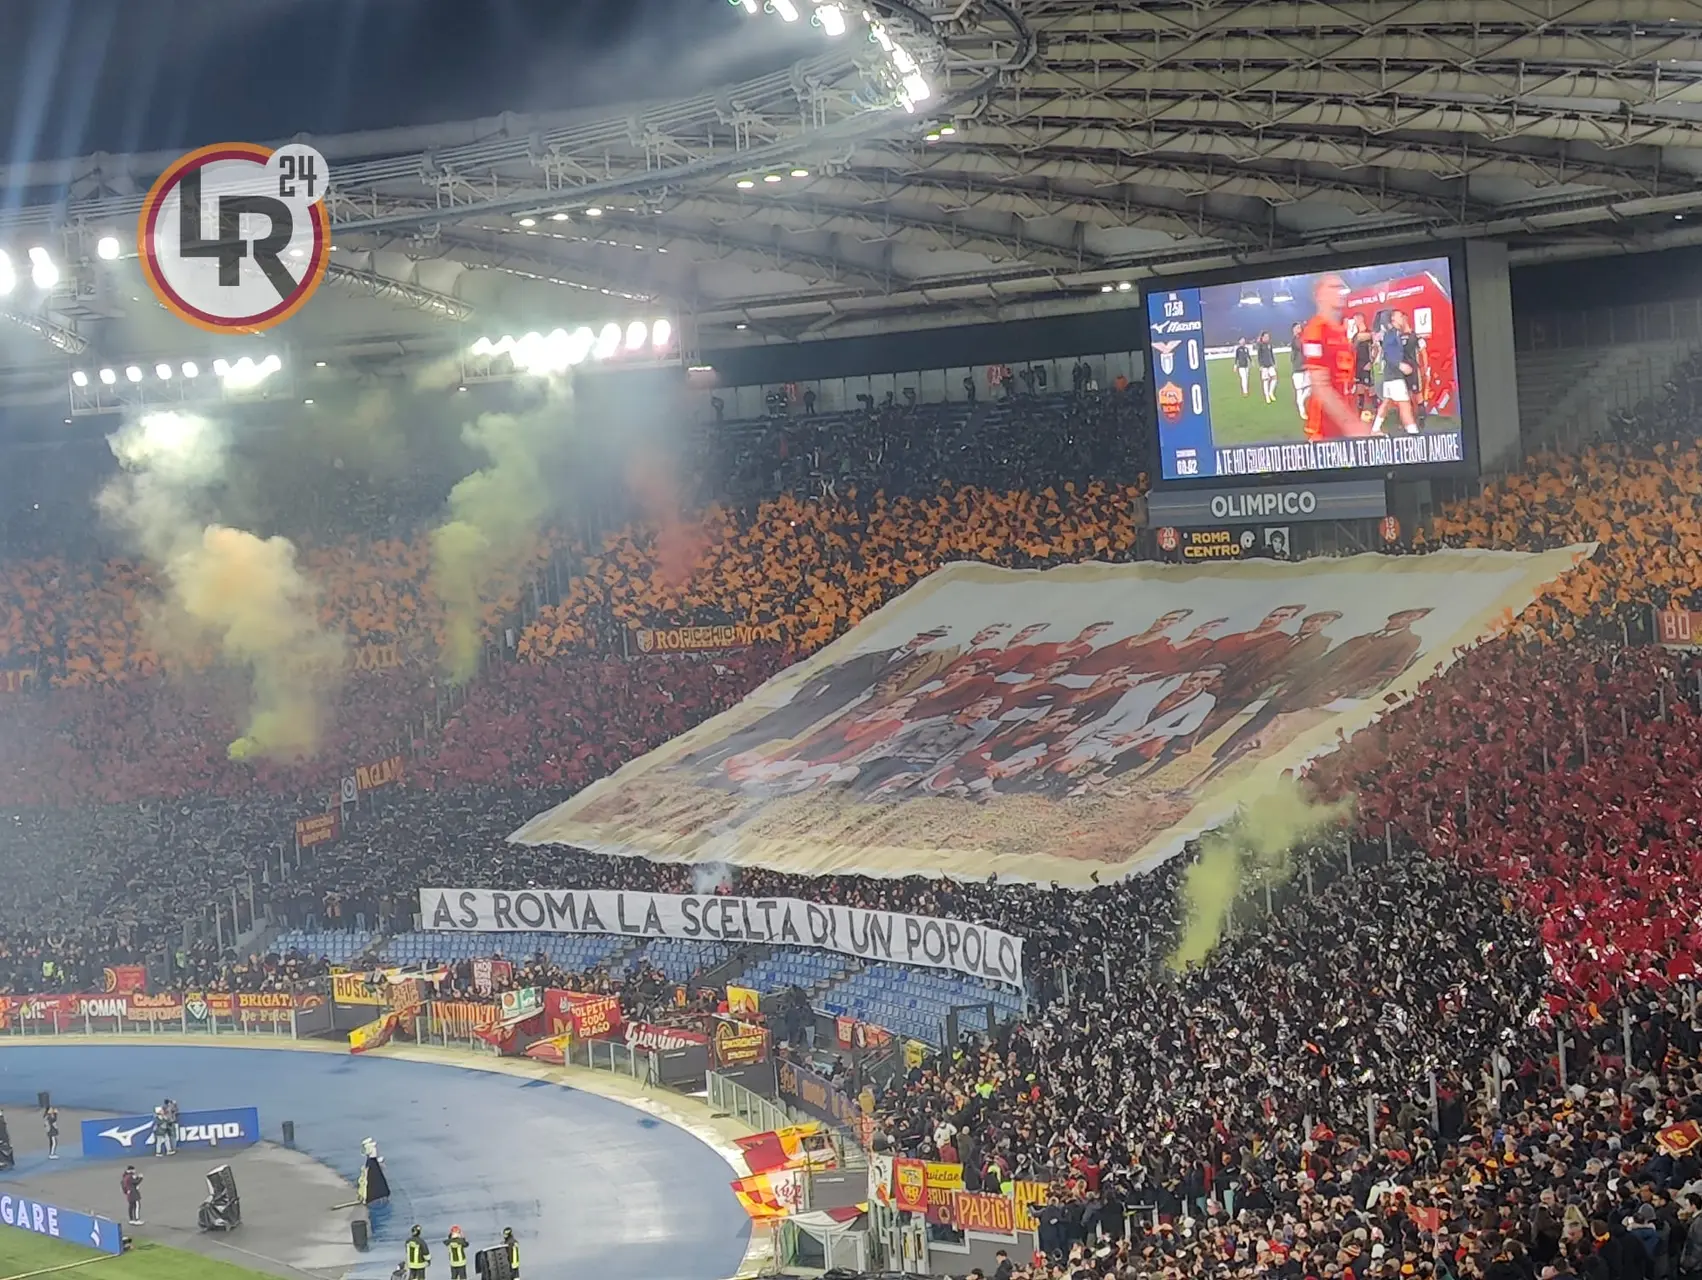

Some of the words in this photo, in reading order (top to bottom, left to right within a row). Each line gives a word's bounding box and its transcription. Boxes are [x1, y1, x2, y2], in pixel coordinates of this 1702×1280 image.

[1188, 339, 1199, 370] 0
[1191, 384, 1203, 415] 0
[1222, 450, 1233, 475] TE
[1356, 439, 1368, 466] TE
[1393, 436, 1428, 464] ETERNO
[1428, 433, 1460, 461] AMORE
[1211, 491, 1316, 517] OLIMPICO
[1184, 544, 1240, 557] CENTRO
[1191, 531, 1231, 544] ROMA
[433, 892, 478, 929] AS
[492, 892, 605, 930] ROMA
[617, 894, 666, 934] LA
[681, 898, 798, 942] SCELTA
[807, 904, 837, 948] DI
[848, 910, 893, 958] UN
[905, 918, 1018, 981] POPOLO
[582, 1012, 606, 1027] SODO
[0, 1195, 59, 1236] GARE
